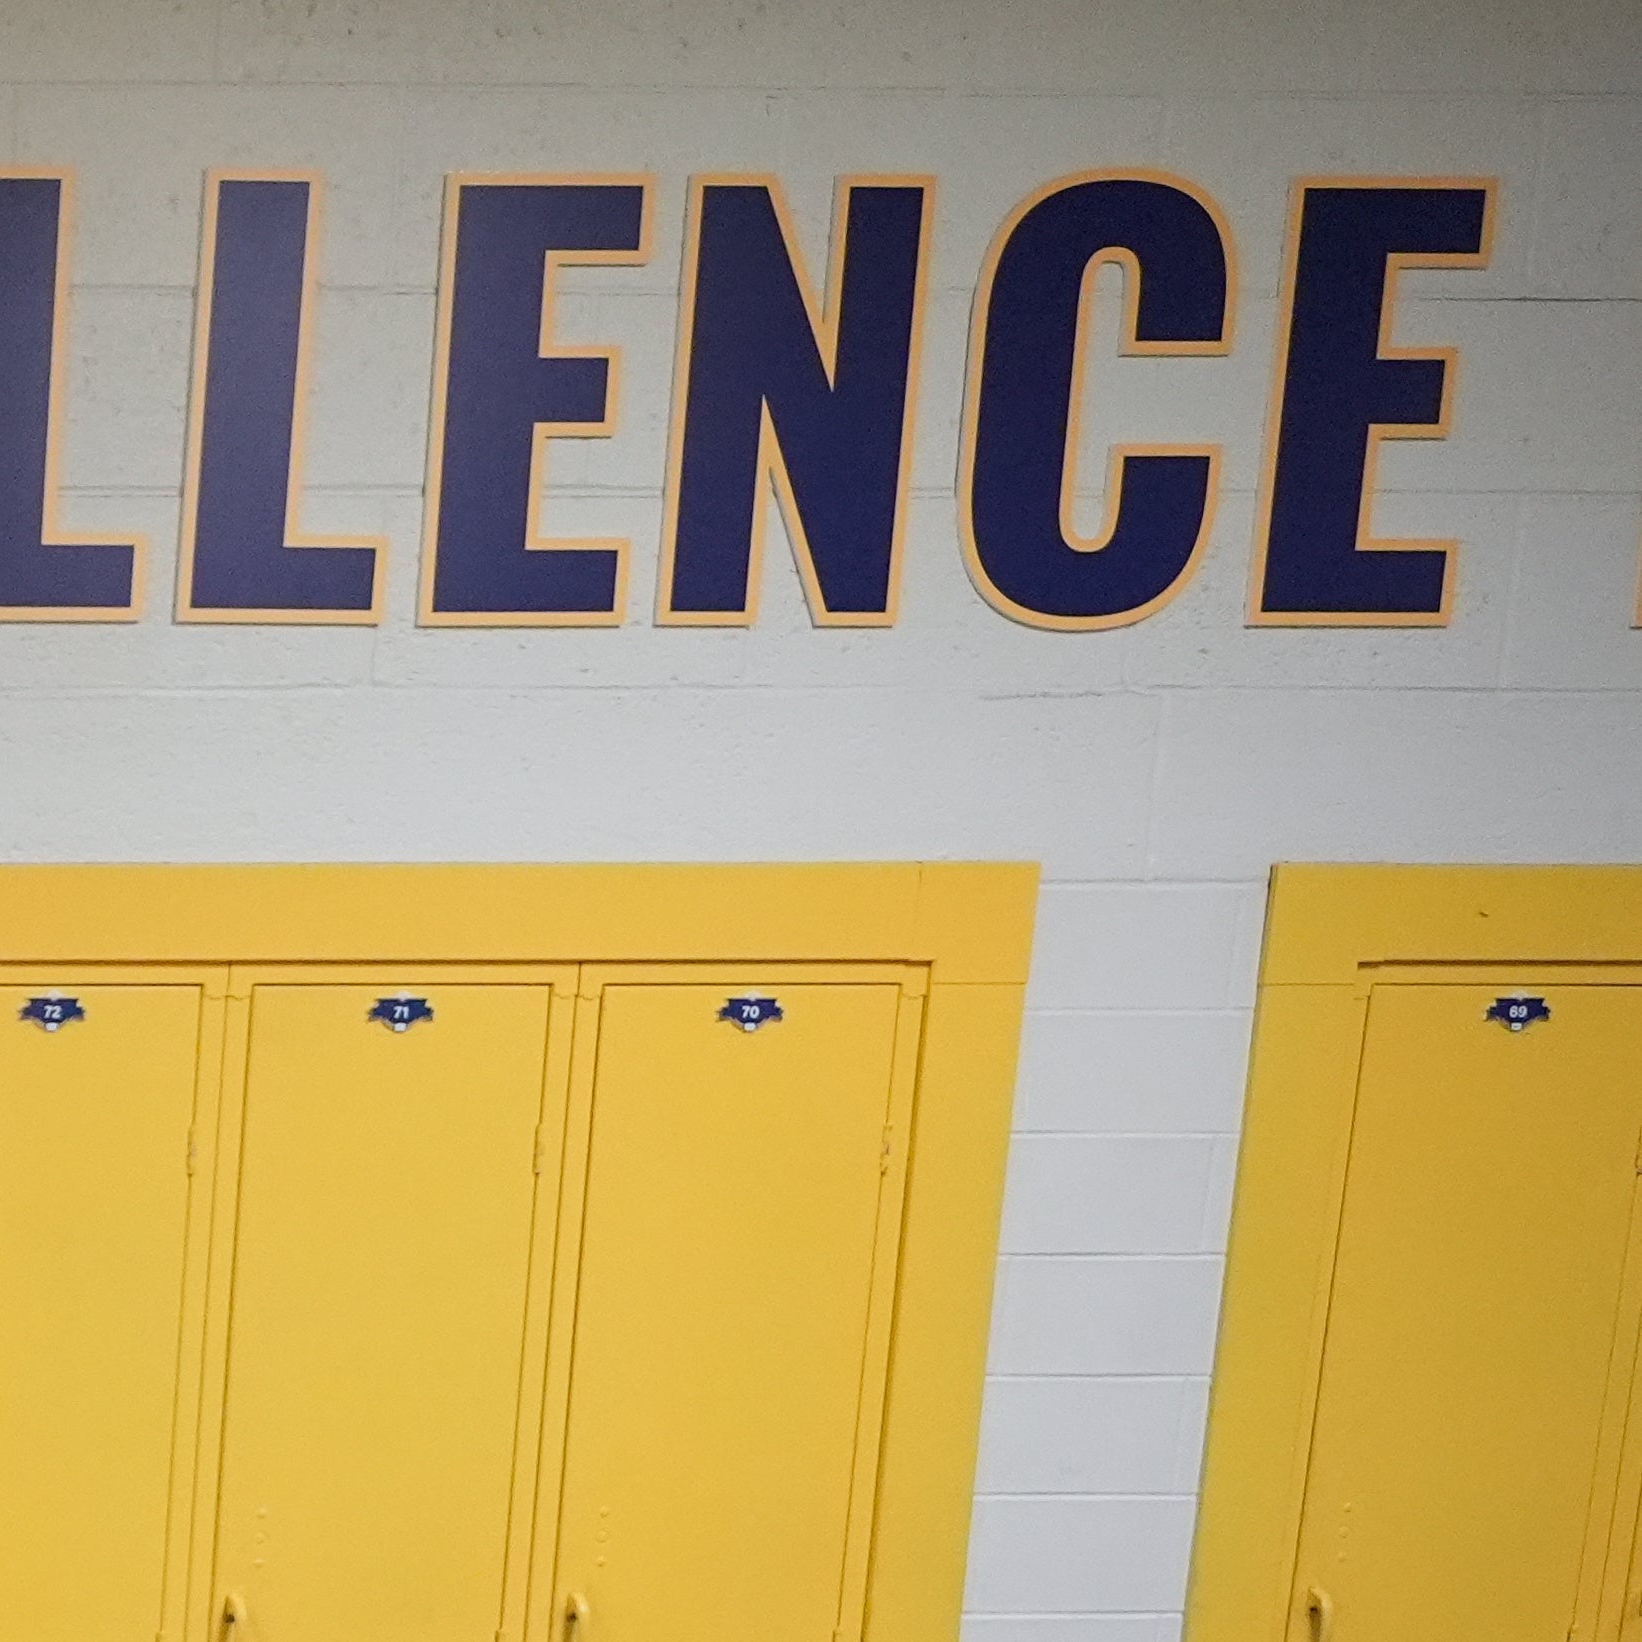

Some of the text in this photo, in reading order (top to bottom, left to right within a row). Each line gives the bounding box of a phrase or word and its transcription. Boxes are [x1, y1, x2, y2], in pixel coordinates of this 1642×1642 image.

[43, 1005, 62, 1019] 72
[393, 1005, 410, 1019] 71
[741, 1005, 760, 1019] 70
[1509, 1005, 1528, 1018] 69
